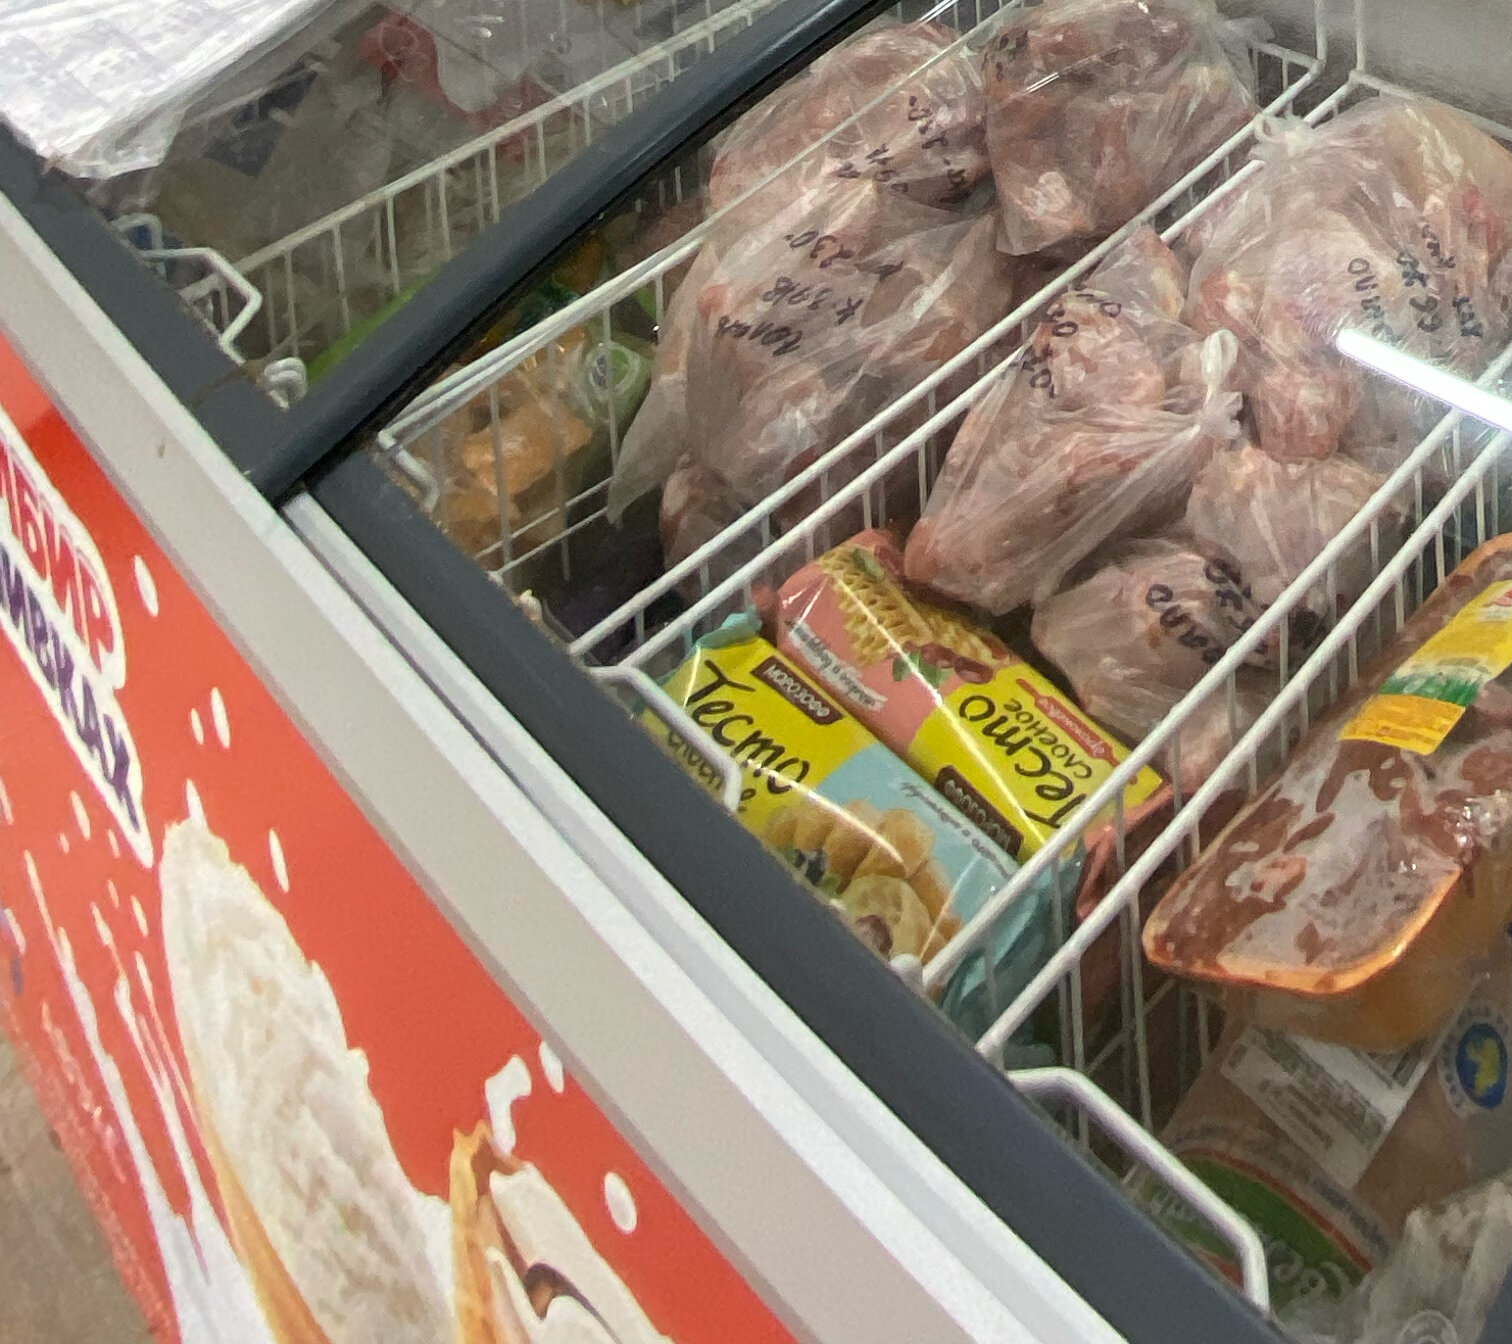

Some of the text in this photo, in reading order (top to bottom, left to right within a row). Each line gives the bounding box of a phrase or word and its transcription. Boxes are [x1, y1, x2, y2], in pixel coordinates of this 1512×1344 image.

[683, 659, 812, 797] Тесто
[957, 692, 1092, 832] Тесто
[1002, 696, 1092, 780] слоеное
